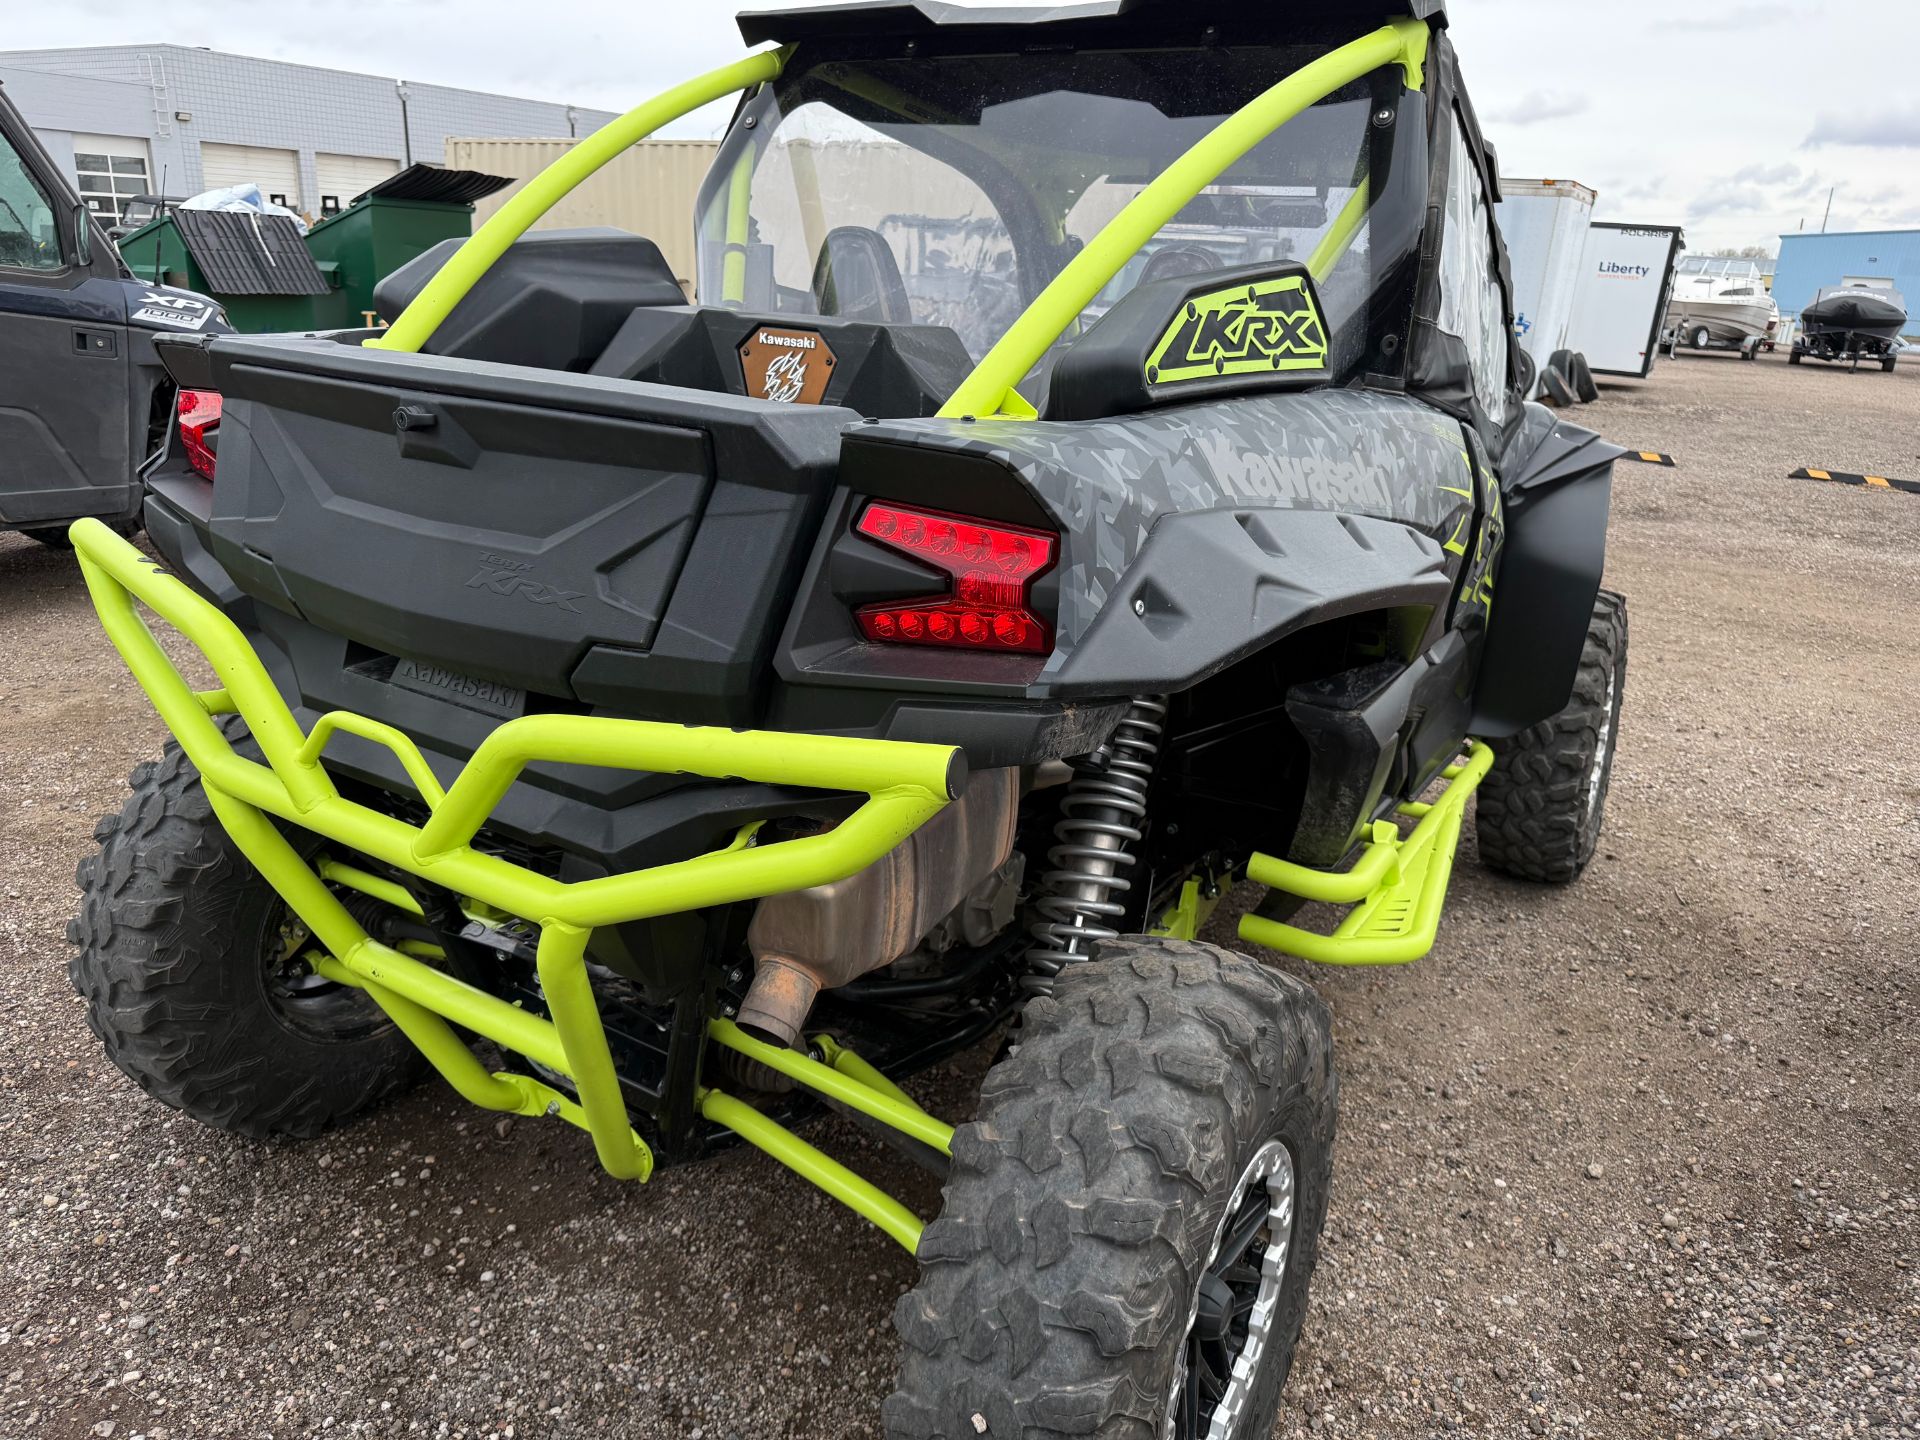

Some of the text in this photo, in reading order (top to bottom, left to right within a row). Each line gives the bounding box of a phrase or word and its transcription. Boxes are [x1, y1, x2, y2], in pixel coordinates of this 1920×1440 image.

[1620, 228, 1670, 239] POLARIS
[1598, 261, 1650, 277] Liberty
[138, 292, 205, 309] XP
[143, 308, 194, 322] 1000
[1189, 307, 1313, 356] KRX
[759, 332, 816, 349] Kawasaki
[463, 565, 590, 614] KRX
